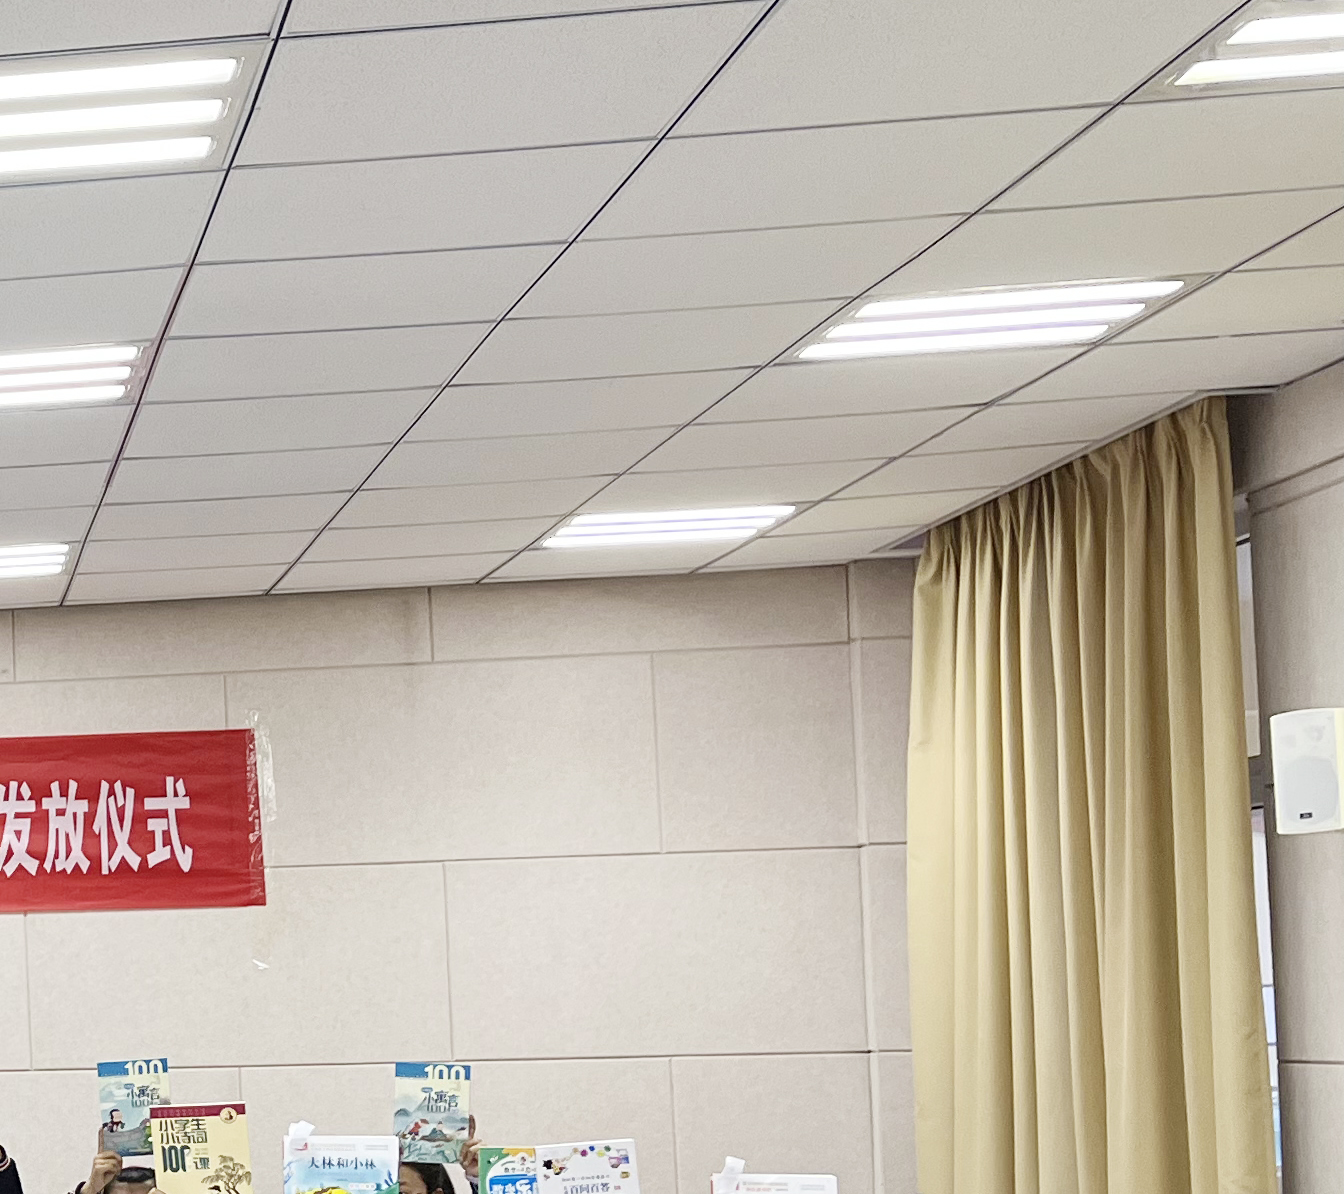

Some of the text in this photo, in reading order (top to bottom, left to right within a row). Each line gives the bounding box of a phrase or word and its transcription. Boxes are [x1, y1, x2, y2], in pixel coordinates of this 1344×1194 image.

[159, 1119, 206, 1131] 小学生
[160, 1131, 208, 1144] 小诗词
[308, 1156, 377, 1170] 大林和小林
